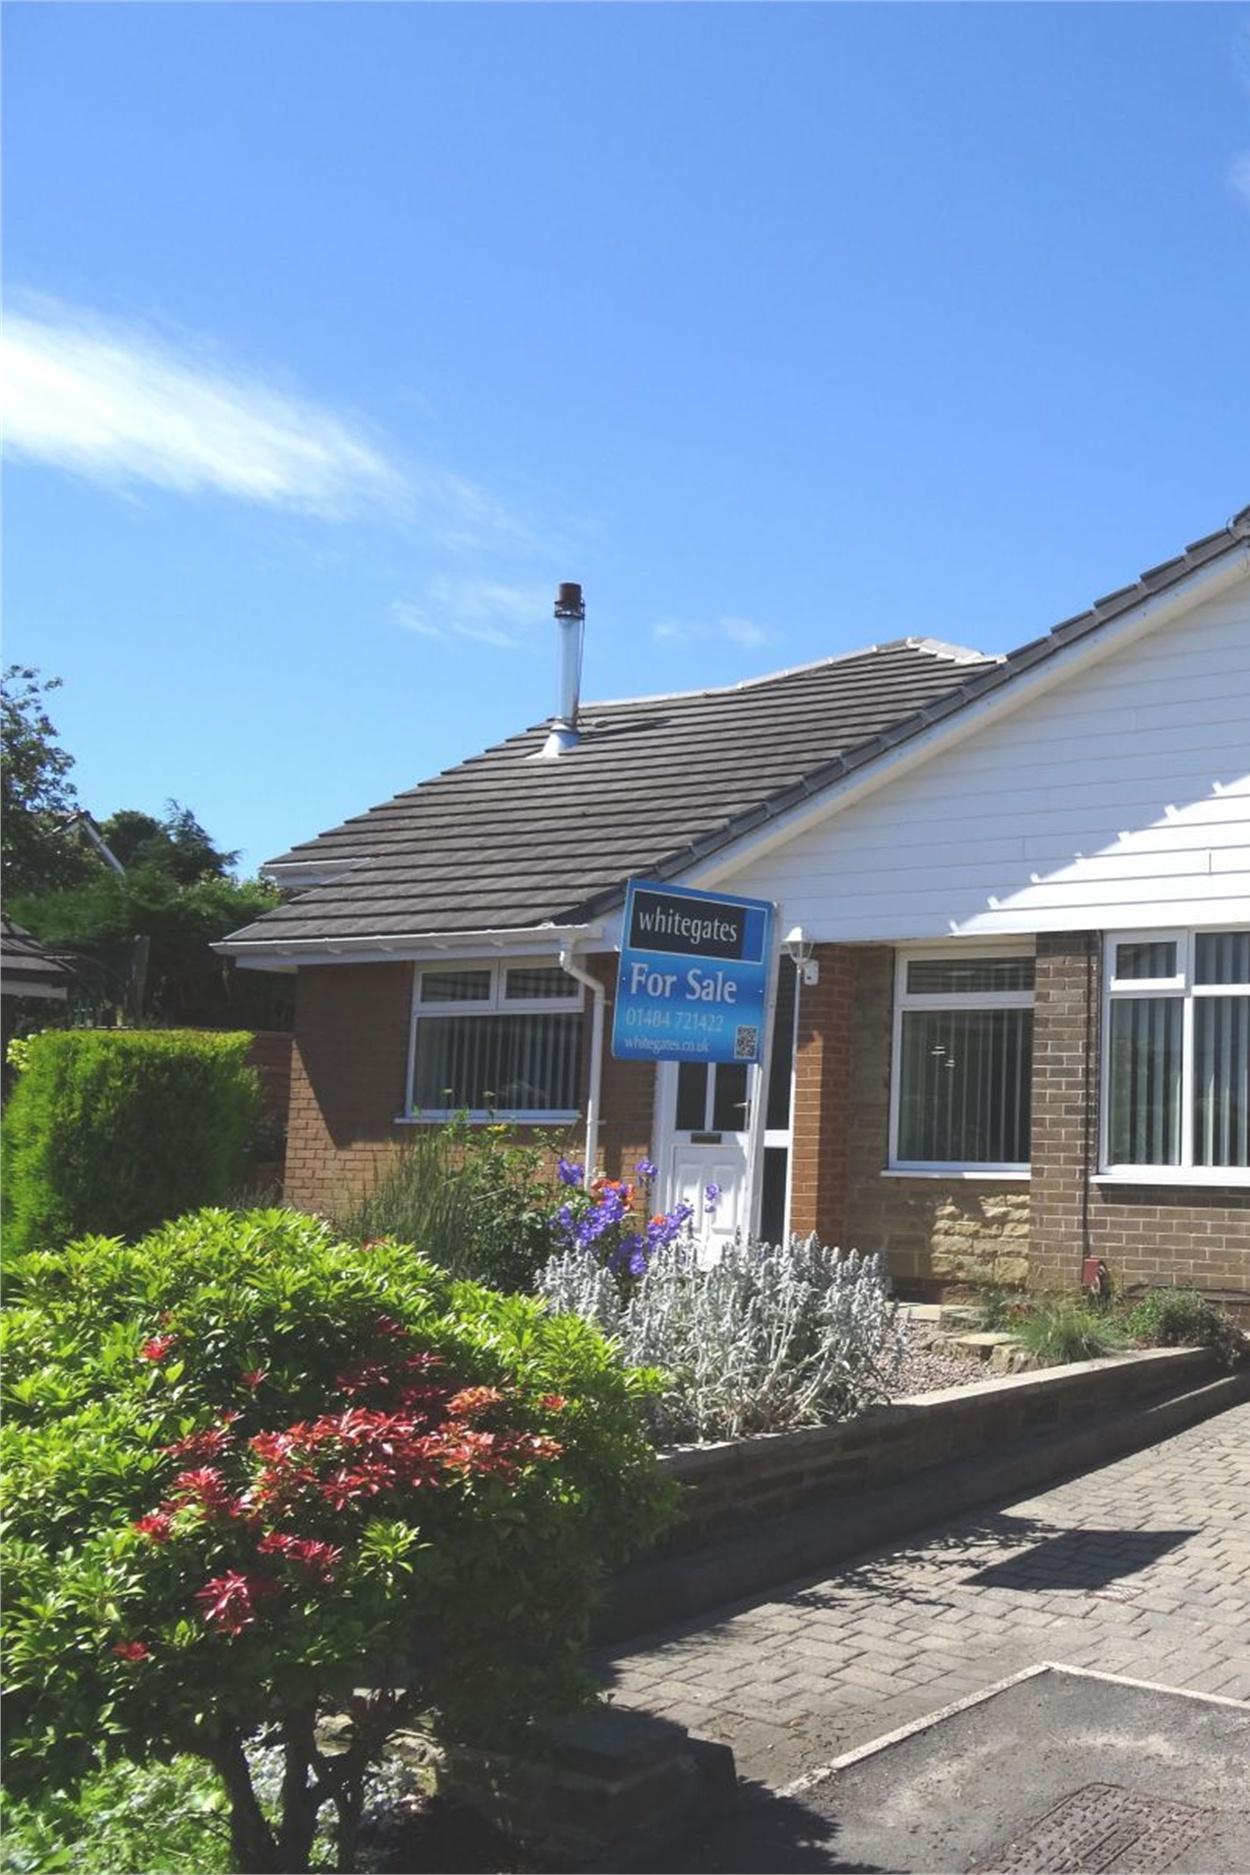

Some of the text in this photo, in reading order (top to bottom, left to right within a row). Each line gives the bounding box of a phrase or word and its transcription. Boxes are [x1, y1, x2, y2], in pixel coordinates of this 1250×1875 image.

[639, 906, 737, 944] whitegates
[630, 962, 738, 1004] For Sale
[625, 1008, 724, 1032] 01484 721422
[624, 1036, 710, 1054] whitegates.co.uk
